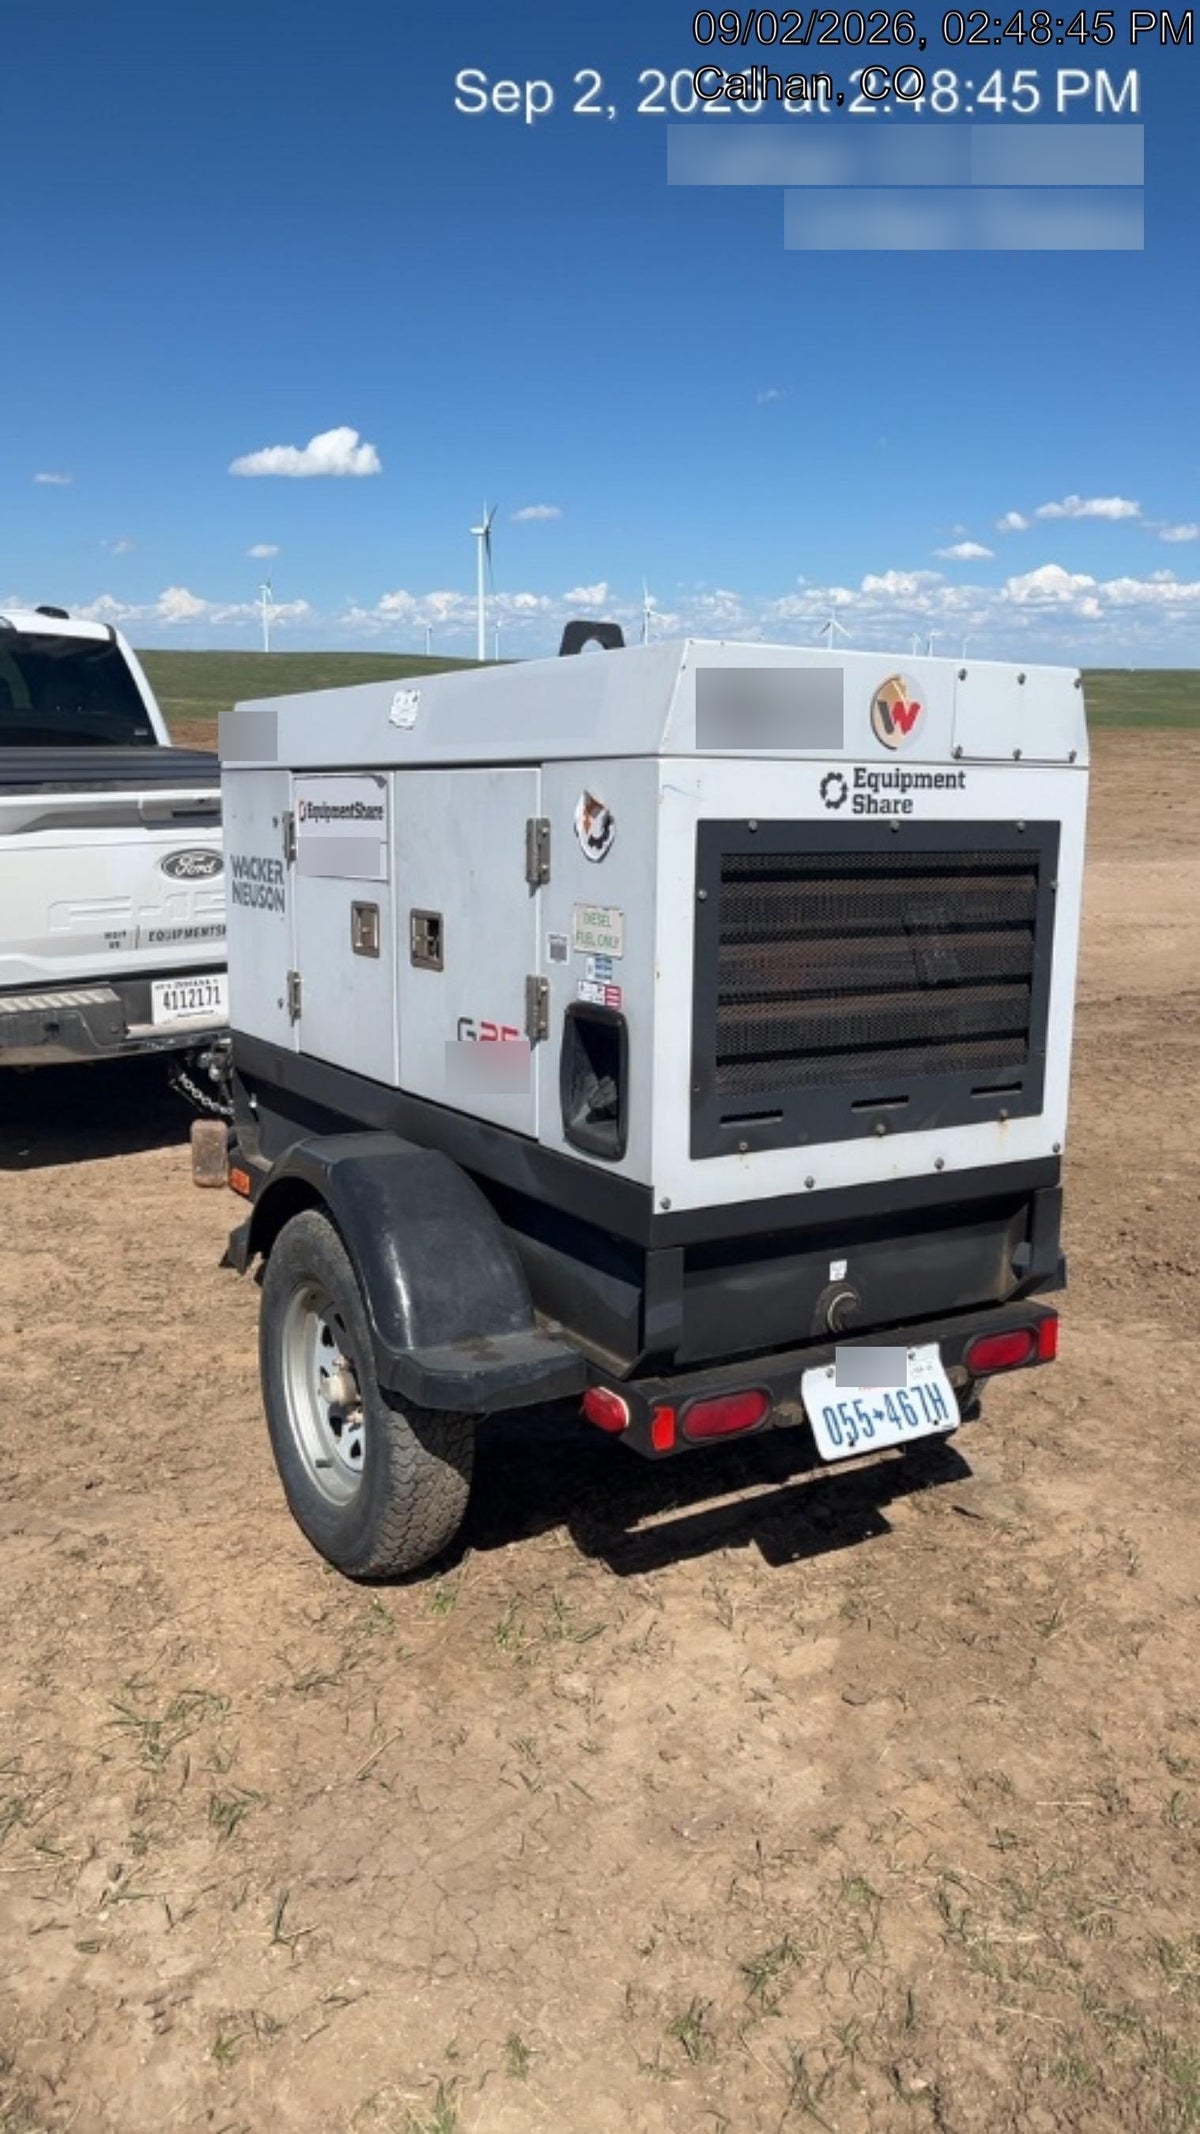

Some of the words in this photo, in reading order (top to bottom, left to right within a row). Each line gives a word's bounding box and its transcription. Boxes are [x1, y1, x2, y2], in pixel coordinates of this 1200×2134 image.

[853, 767, 966, 792] Equipment
[307, 801, 383, 823] EquipmentShare
[852, 794, 914, 815] Share
[175, 855, 216, 876] Ford
[230, 854, 284, 885] WACKER
[231, 881, 285, 913] NEUSON
[583, 912, 612, 928] DIESEL
